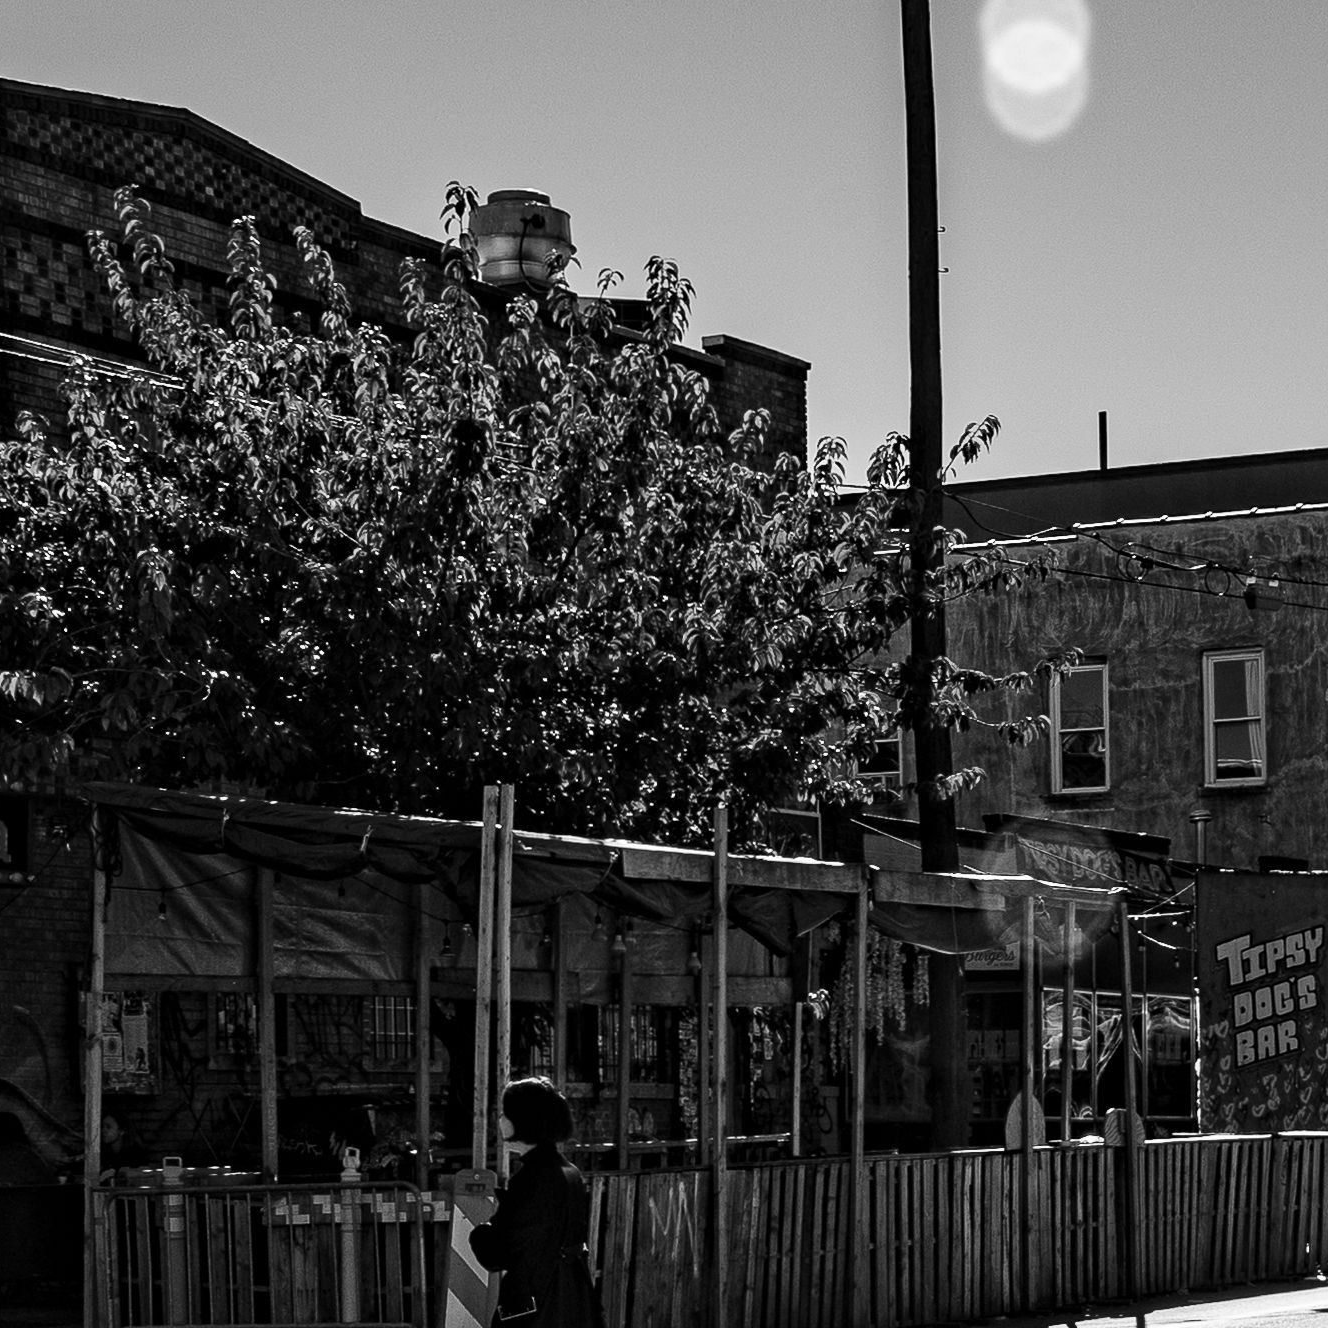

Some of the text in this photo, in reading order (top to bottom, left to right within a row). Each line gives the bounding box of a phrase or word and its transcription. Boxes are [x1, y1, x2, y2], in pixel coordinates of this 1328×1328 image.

[1124, 855, 1174, 893] BAR
[1215, 925, 1324, 987] TIPSY
[1233, 974, 1318, 1028] DOG'S
[1236, 1019, 1299, 1068] BAR
